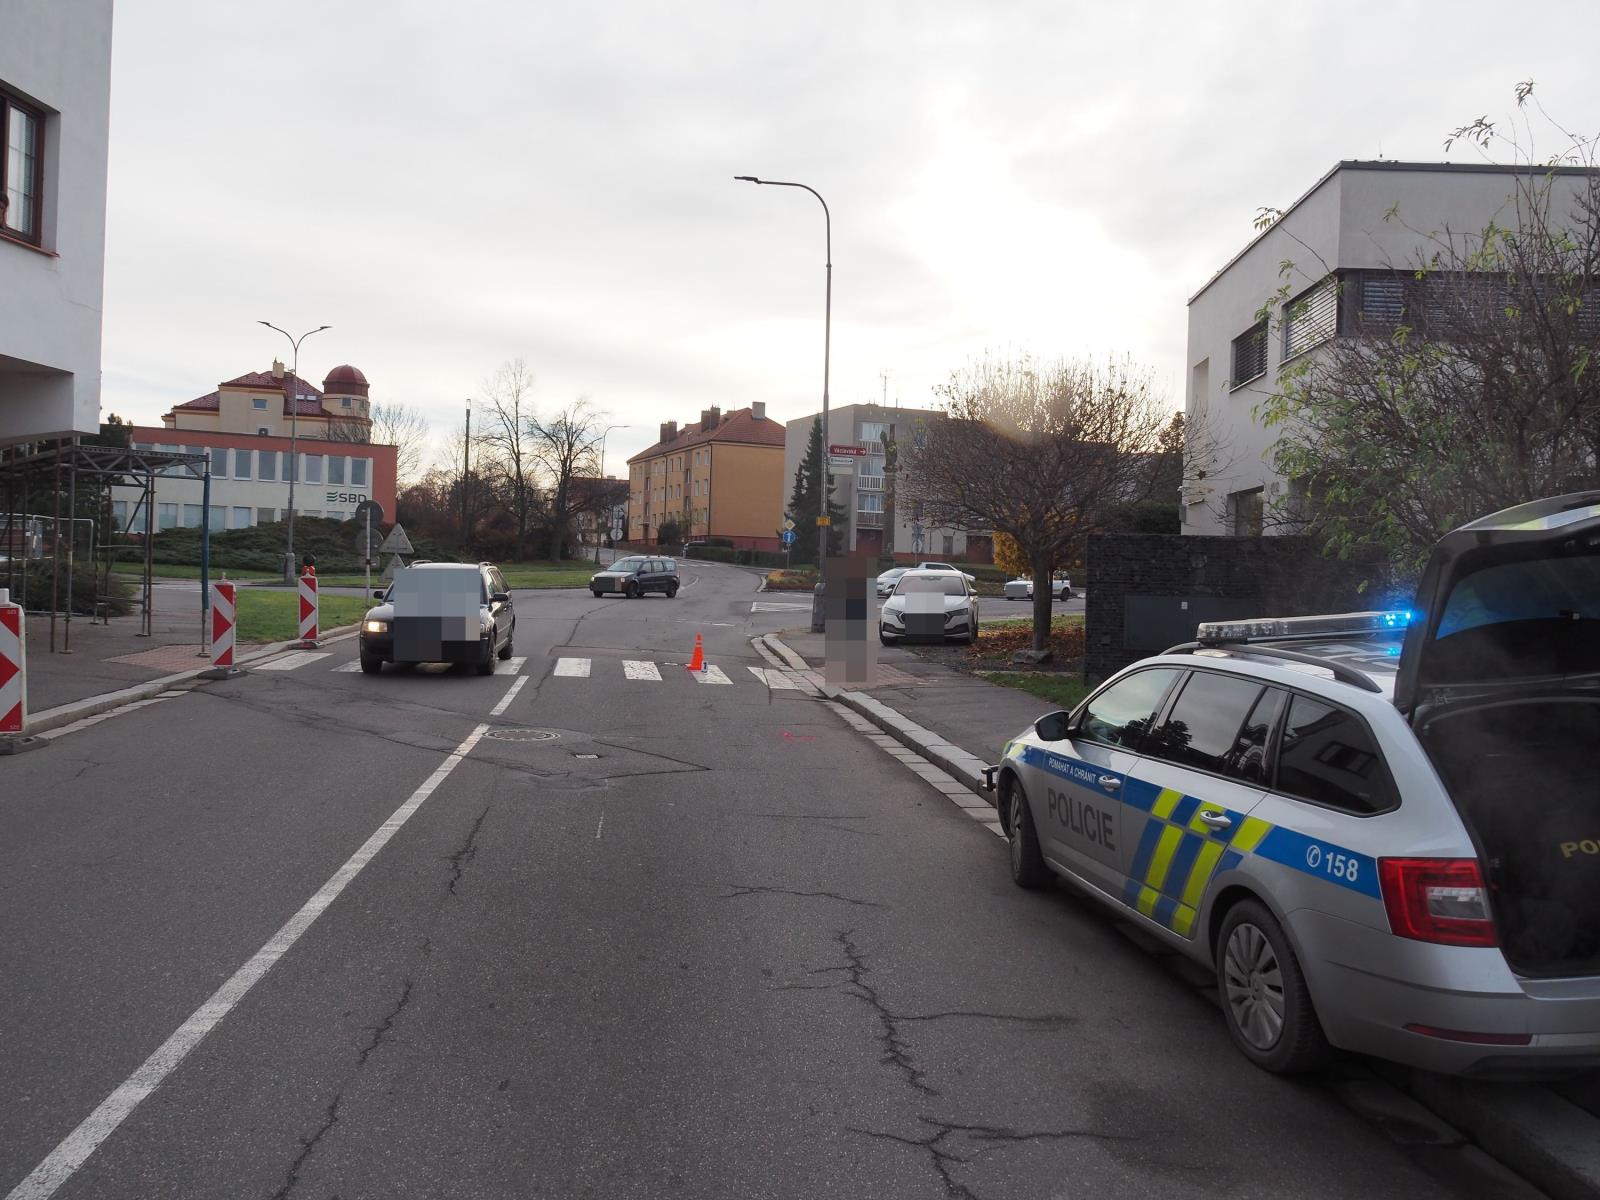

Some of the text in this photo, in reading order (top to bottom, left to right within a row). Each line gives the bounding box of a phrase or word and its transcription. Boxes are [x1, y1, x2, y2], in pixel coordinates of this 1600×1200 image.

[339, 493, 367, 503] SBD
[1069, 766, 1075, 776] A
[1048, 787, 1116, 852] POLICIE
[1326, 852, 1358, 882] 158
